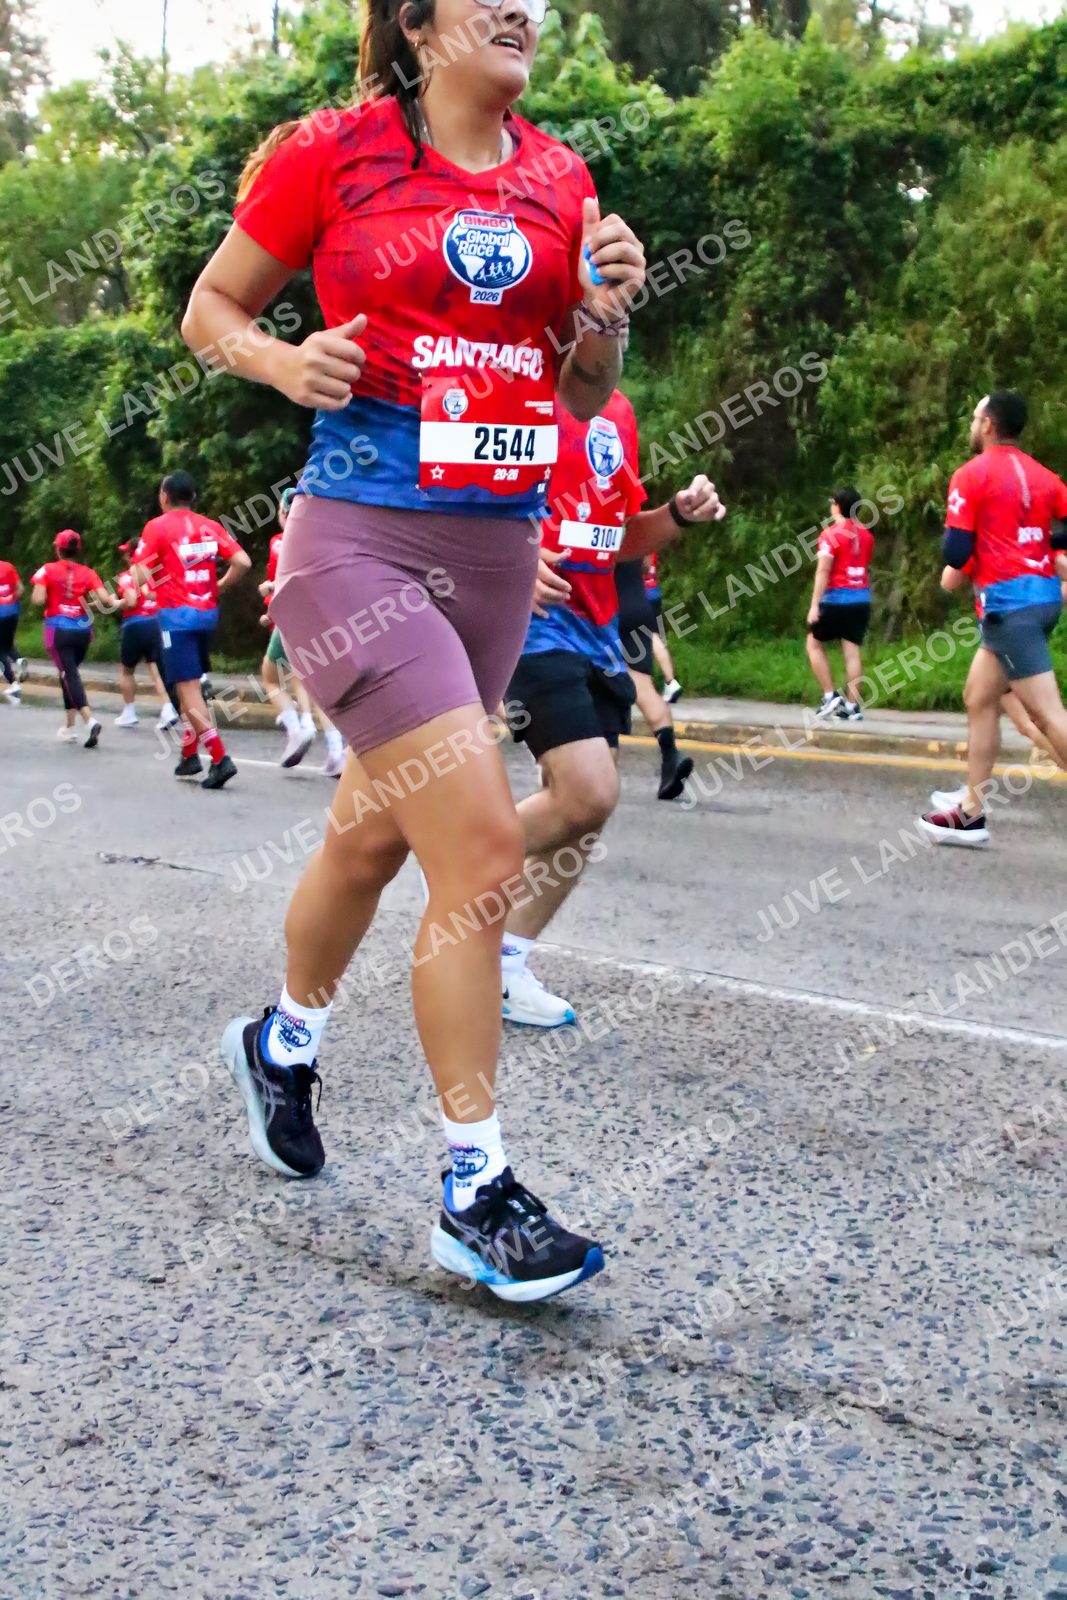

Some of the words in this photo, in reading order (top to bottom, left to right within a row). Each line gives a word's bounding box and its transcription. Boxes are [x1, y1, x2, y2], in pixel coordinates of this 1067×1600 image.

[464, 216, 508, 228] BIMBO
[466, 229, 510, 247] Global
[458, 240, 495, 257] Race
[473, 290, 500, 302] 2026
[411, 335, 543, 381] SANTIAGO
[474, 426, 536, 461] 2544
